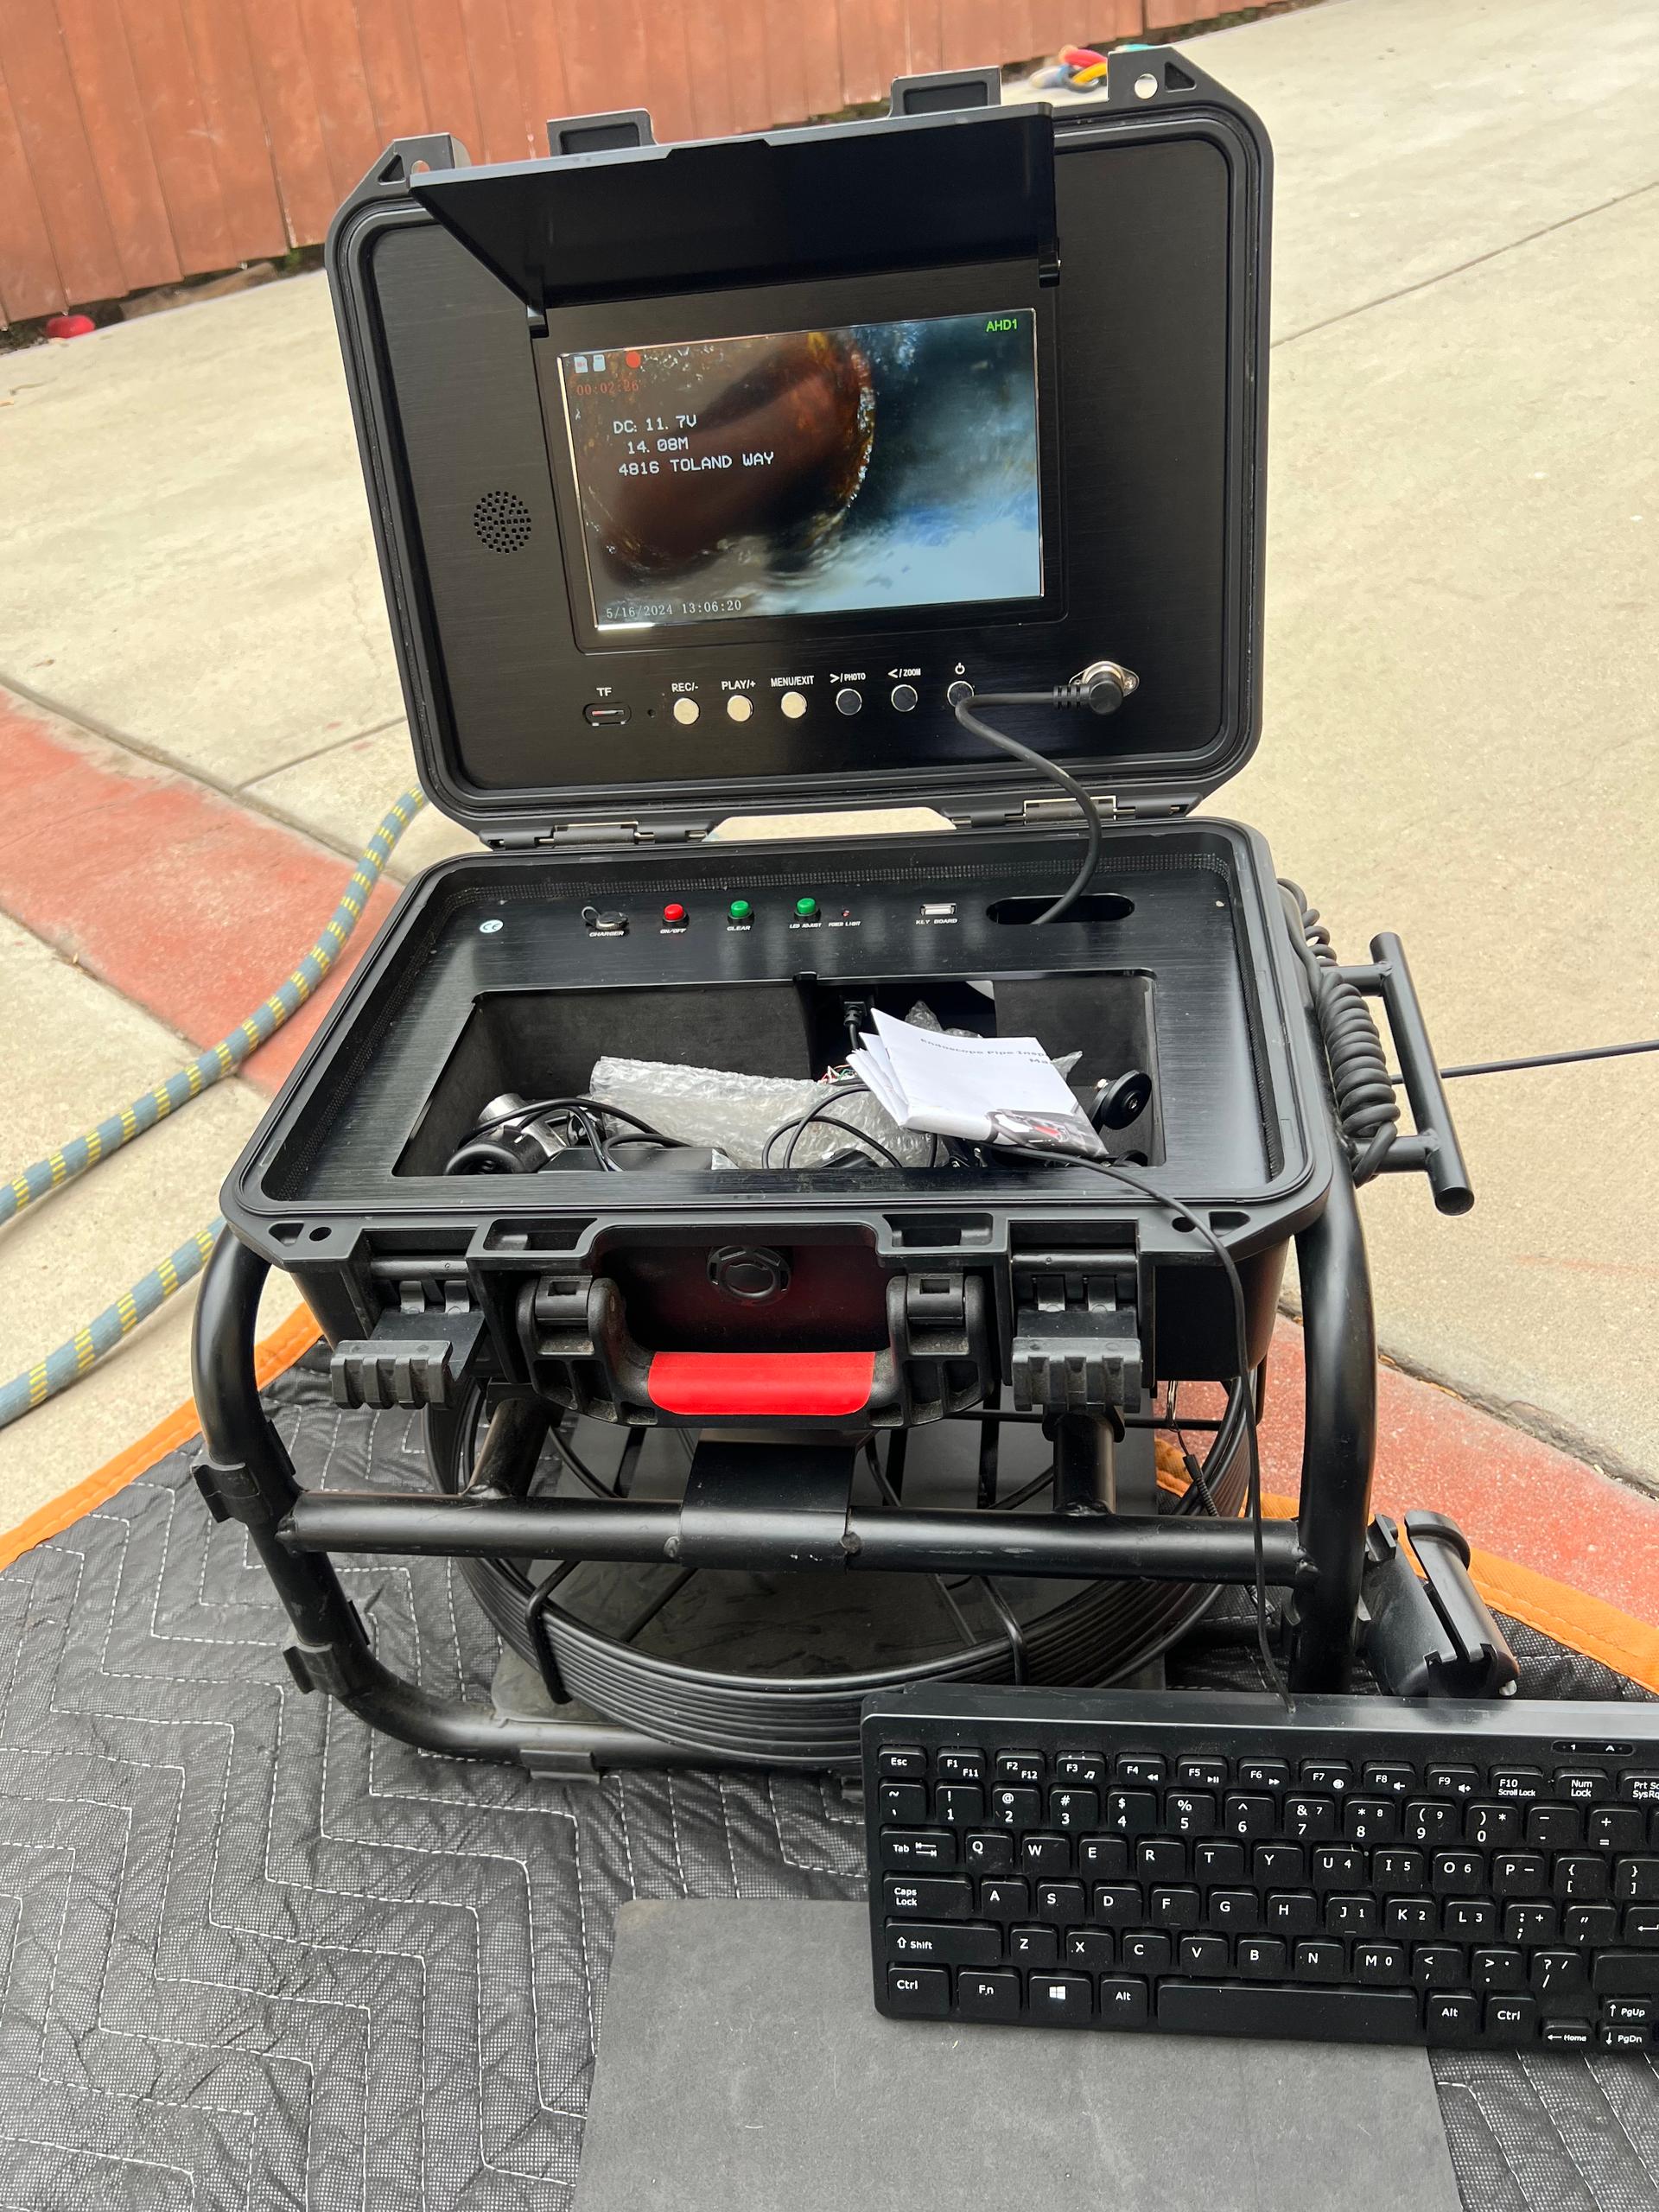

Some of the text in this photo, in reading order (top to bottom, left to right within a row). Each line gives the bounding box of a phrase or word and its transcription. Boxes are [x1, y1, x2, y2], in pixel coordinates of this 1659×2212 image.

[986, 318, 1018, 333] AHD1
[618, 451, 775, 477] 4816 TOLAND WAY
[606, 600, 742, 620] 5/16/2024 13:06:20
[671, 682, 699, 693] REC/-
[721, 679, 756, 691] PLAY/+
[770, 675, 815, 688] MENU/EXIT
[596, 687, 613, 697] TF
[890, 1757, 908, 1766] Esc
[946, 1758, 958, 1769] F1
[1006, 1761, 1019, 1770] F2
[1066, 1763, 1078, 1772] F3
[963, 1768, 979, 1778] F11
[1020, 1770, 1038, 1780] F12
[1127, 1765, 1139, 1775] F4
[1188, 1768, 1201, 1777] F5
[1250, 1770, 1262, 1779] F6
[1313, 1772, 1325, 1781] F7
[1375, 1774, 1388, 1783] F8
[1438, 1777, 1451, 1786] F9
[1499, 1778, 1518, 1788] F10
[1571, 1779, 1593, 1789] Num
[1633, 1781, 1648, 1789] Prt
[1497, 1788, 1536, 1797] Scroll Lock
[1570, 1788, 1592, 1798] Lock
[947, 1808, 955, 1821] 1
[1005, 1810, 1014, 1823] 2
[1316, 1806, 1323, 1815] 7
[1376, 1808, 1383, 1817] 8
[1436, 1810, 1444, 1820] 9
[1061, 1812, 1071, 1825] 3
[1117, 1815, 1128, 1827] 4
[1180, 1817, 1189, 1829] 5
[1237, 1821, 1248, 1834] 6
[1298, 1823, 1307, 1835] 7
[1356, 1825, 1366, 1838] 8
[1416, 1827, 1427, 1840] 9
[1477, 1829, 1487, 1843] 0
[893, 1844, 910, 1853] Tab
[971, 1840, 984, 1855] Q
[1027, 1844, 1042, 1857] W
[1088, 1847, 1097, 1859] E
[1145, 1849, 1155, 1861] R
[1204, 1852, 1215, 1864] T
[1264, 1854, 1274, 1866] Y
[1323, 1857, 1351, 1869] U 4
[1385, 1859, 1411, 1872] I 5
[1443, 1861, 1471, 1874] O 6
[1505, 1864, 1516, 1876] P
[893, 1886, 918, 1897] Caps
[989, 1890, 1001, 1902] A
[895, 1897, 918, 1907] Lock
[1046, 1892, 1057, 1904] S
[1103, 1895, 1114, 1907] D
[1162, 1897, 1171, 1910] F
[1219, 1900, 1230, 1912] G
[1278, 1904, 1289, 1916] H
[1339, 1906, 1365, 1918] J 1
[1397, 1908, 1426, 1921] K 2
[1459, 1910, 1483, 1923] L 3
[910, 1941, 933, 1950] Shift
[1020, 1938, 1029, 1950] Z
[1075, 1941, 1085, 1953] X
[1134, 1943, 1144, 1955] C
[1192, 1946, 1202, 1958] V
[1249, 1949, 1260, 1961] B
[1307, 1952, 1319, 1964] N
[1365, 1955, 1377, 1967] M
[896, 1979, 918, 1990] Ctrl
[978, 1984, 995, 1995] Fn
[1115, 1991, 1132, 2001] Alt
[1441, 2007, 1459, 2018] Alt
[1497, 2010, 1521, 2021] Ctrl
[1620, 2007, 1646, 2018] PgUp
[1563, 2033, 1587, 2042] Home
[1618, 2034, 1643, 2044] PgDn
